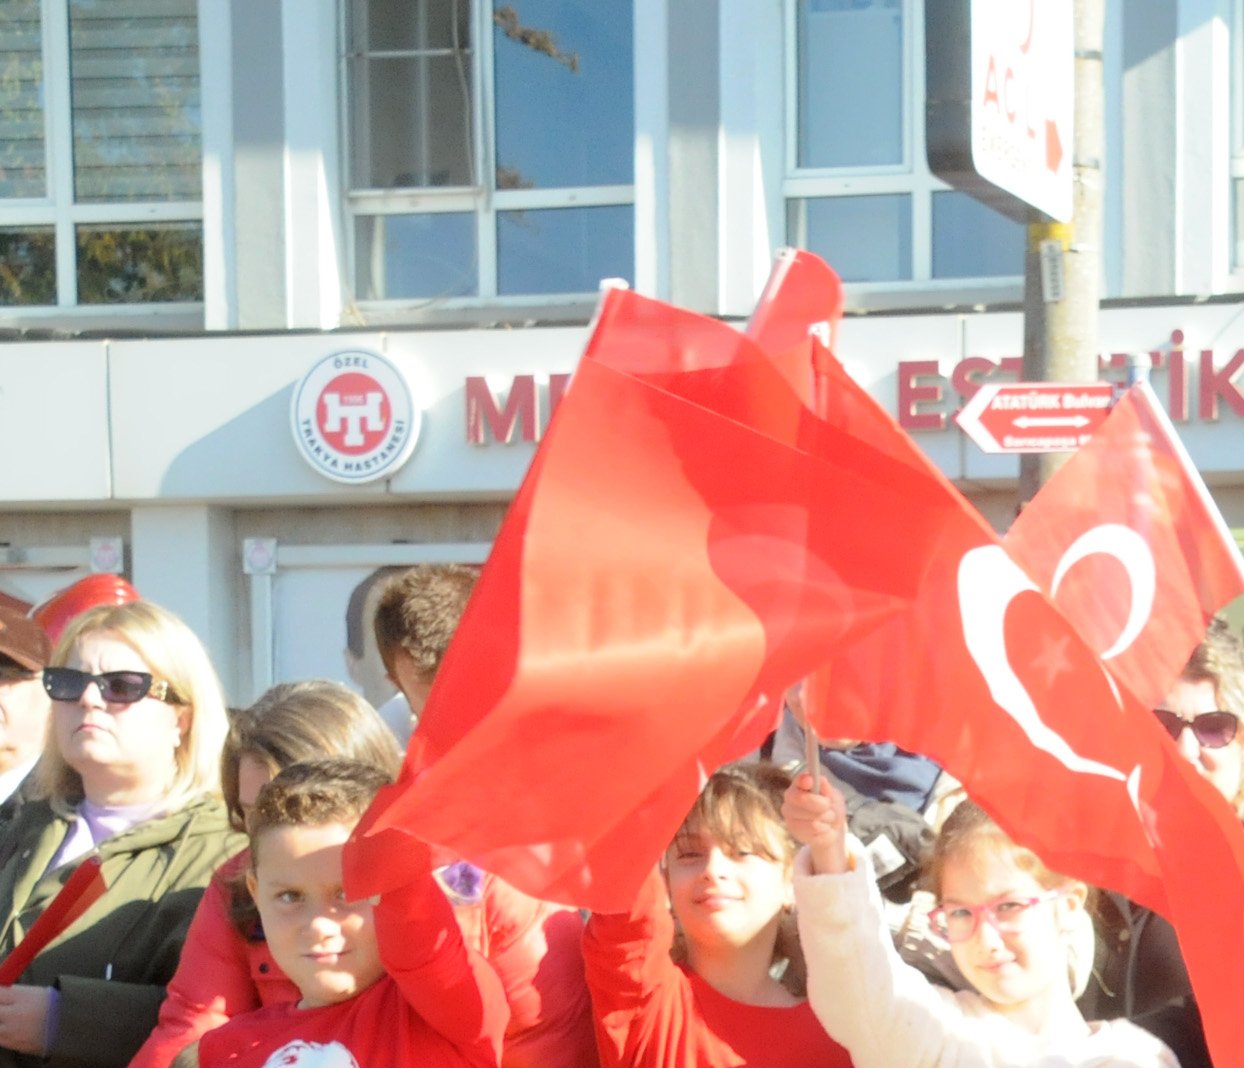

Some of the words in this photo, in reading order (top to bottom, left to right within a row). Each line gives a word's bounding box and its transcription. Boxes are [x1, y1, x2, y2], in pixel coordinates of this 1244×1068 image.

[333, 357, 369, 369] ÖZEL
[991, 391, 1061, 409] ATATÜRK
[302, 418, 339, 468] TRAKYA
[344, 419, 405, 471] HASTANESİ
